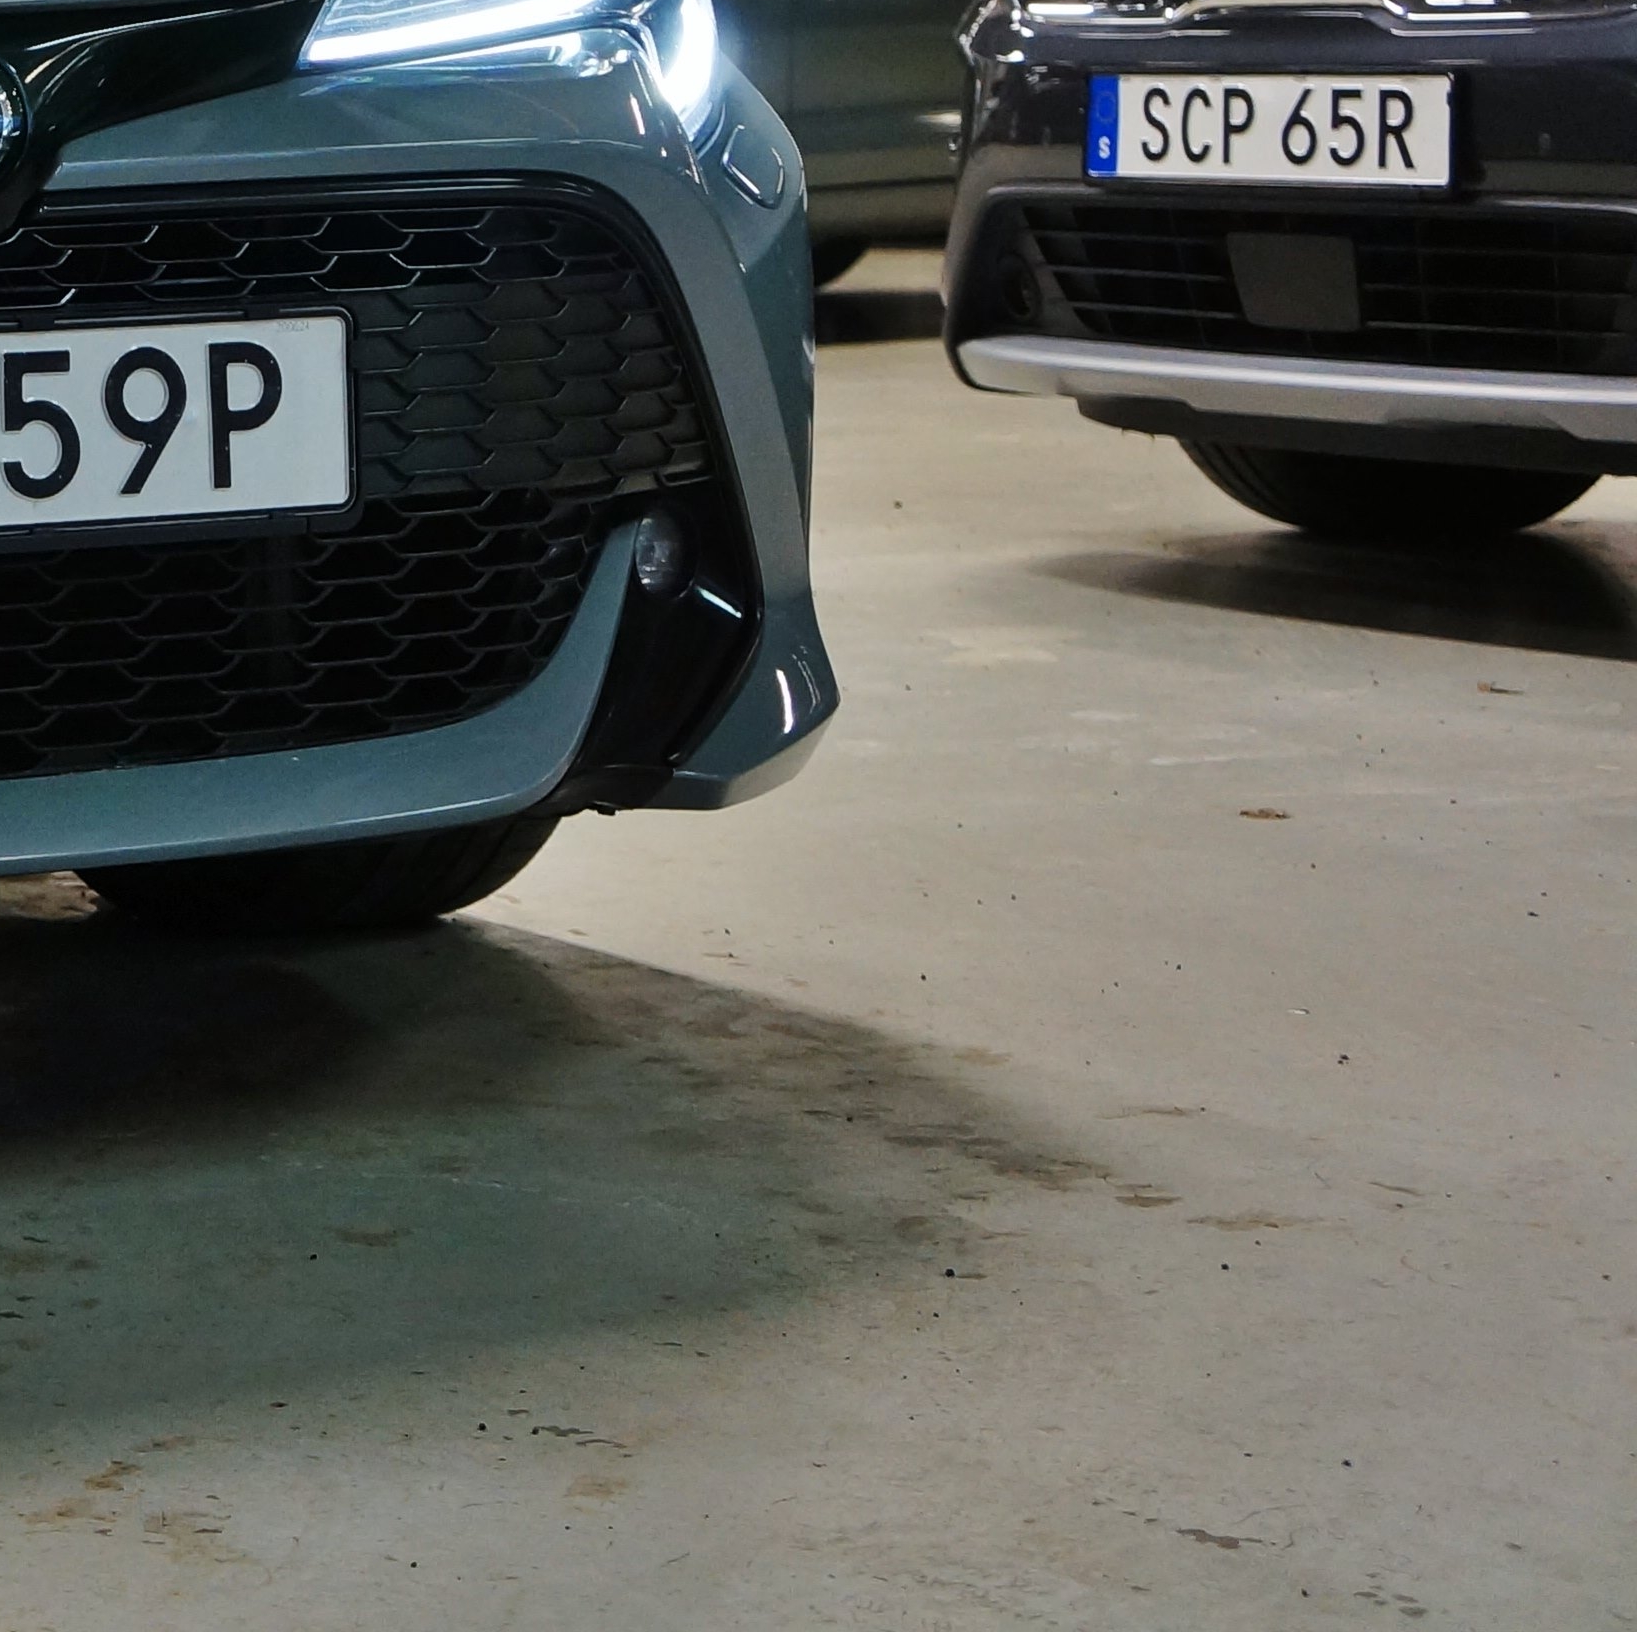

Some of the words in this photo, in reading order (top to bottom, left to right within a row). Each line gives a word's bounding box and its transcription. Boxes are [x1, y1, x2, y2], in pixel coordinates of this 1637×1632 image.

[1098, 135, 1111, 160] S
[1140, 84, 1256, 165] SCP
[1280, 84, 1417, 171] 65R
